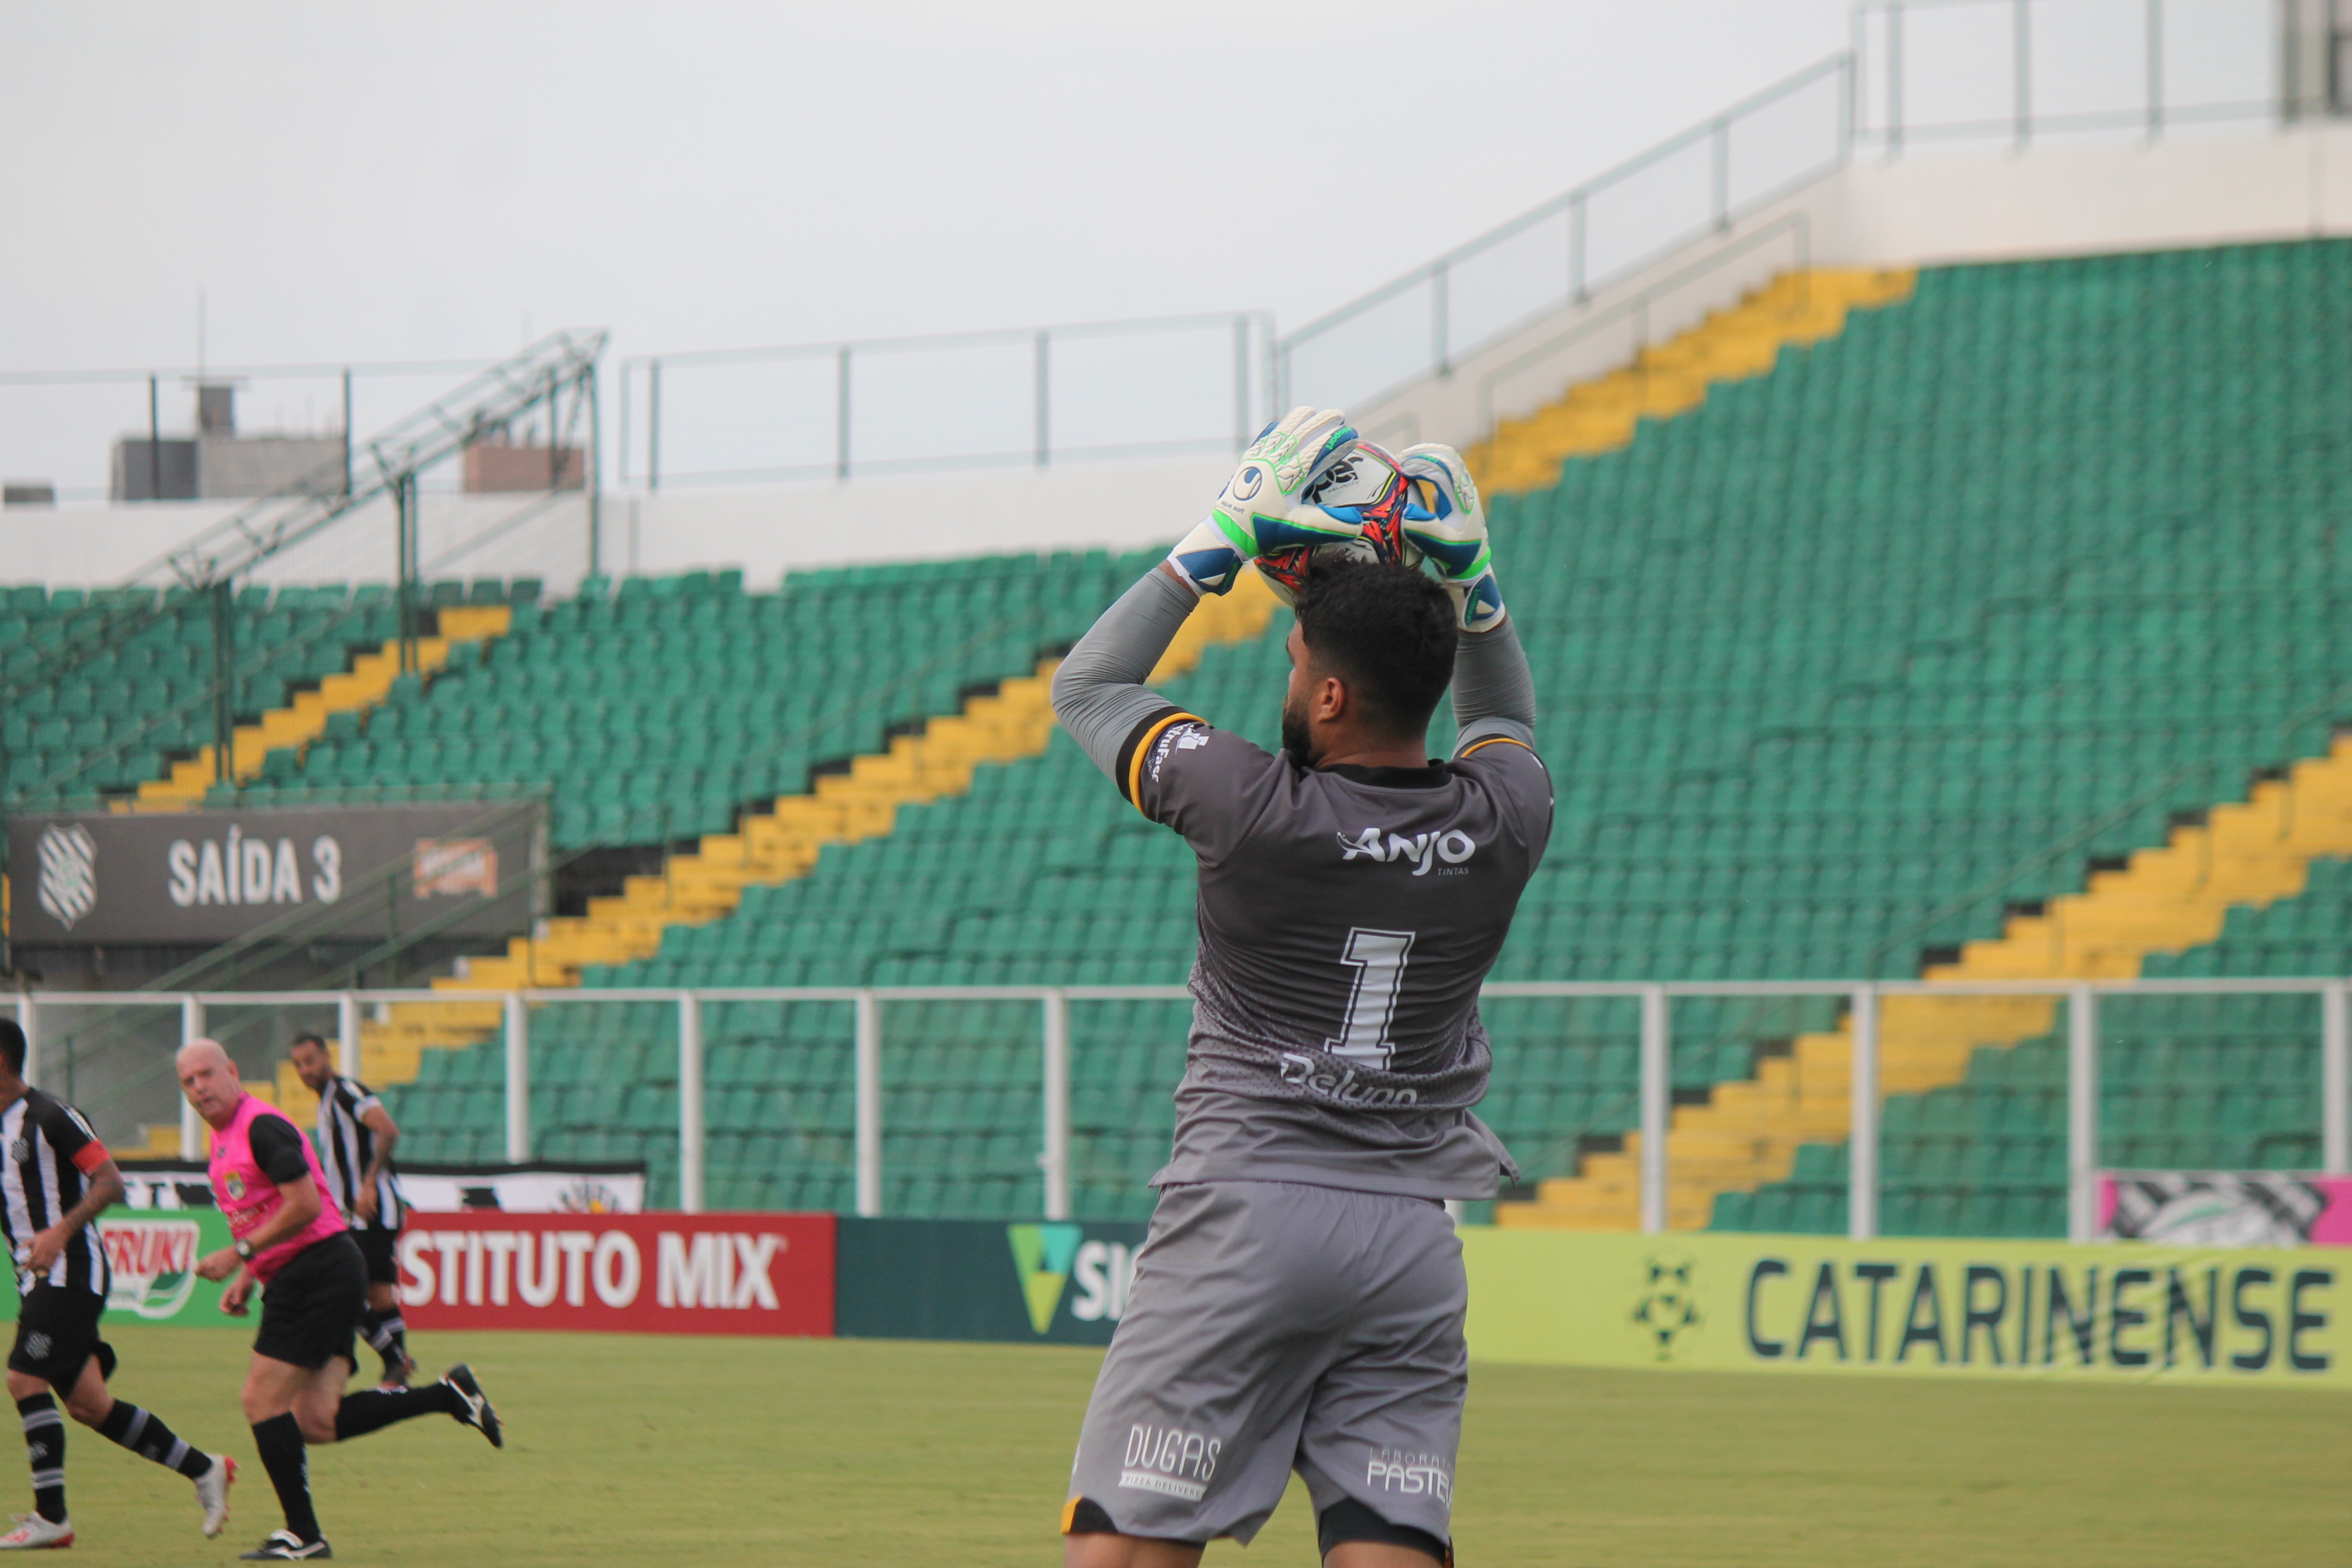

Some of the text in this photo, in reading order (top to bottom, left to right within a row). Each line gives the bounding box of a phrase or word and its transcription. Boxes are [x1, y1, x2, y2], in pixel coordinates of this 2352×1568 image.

[1327, 480, 1359, 493] VELOCITY
[168, 823, 302, 907] SAÍDA
[312, 835, 342, 905] 3
[1438, 867, 1469, 875] TINTAS
[1324, 927, 1415, 1071] 1
[394, 1228, 780, 1311] STITUTO MIX
[1071, 1240, 1145, 1321] SI
[1742, 1257, 2335, 1373] CATARINENSE
[1124, 1424, 1221, 1481] DUGAS
[1124, 1475, 1200, 1497] PIZZA DELIVERY
